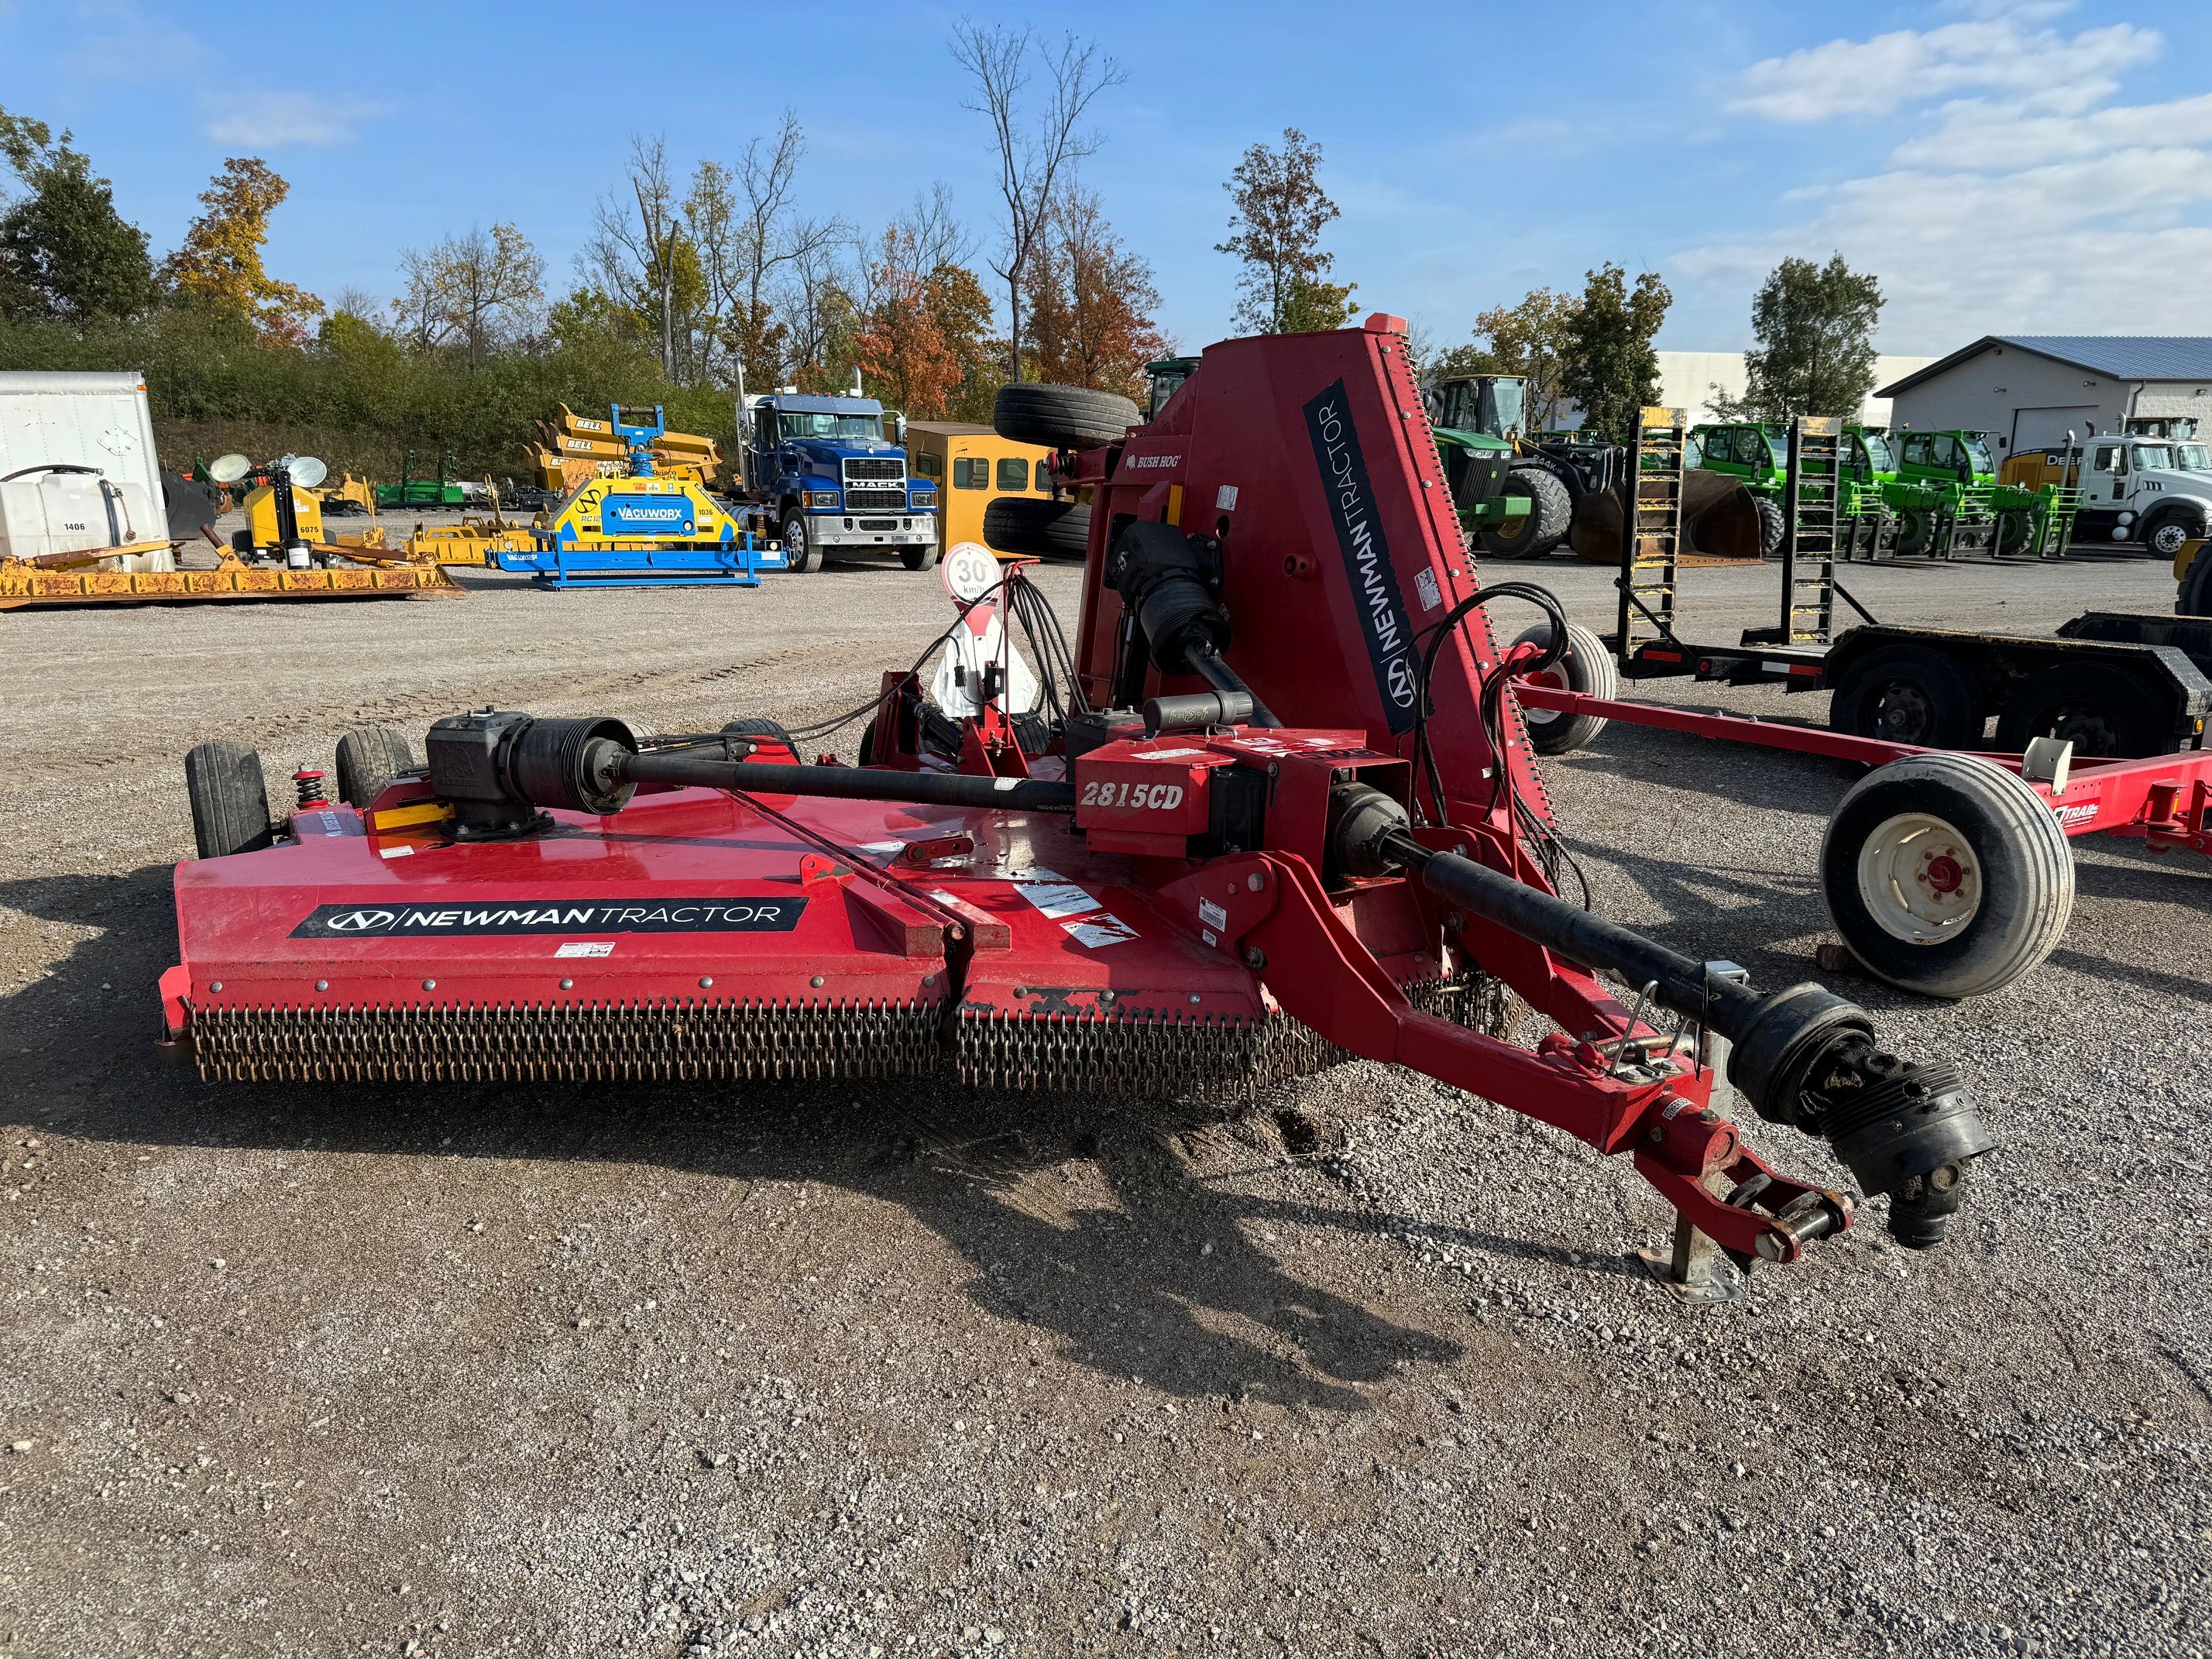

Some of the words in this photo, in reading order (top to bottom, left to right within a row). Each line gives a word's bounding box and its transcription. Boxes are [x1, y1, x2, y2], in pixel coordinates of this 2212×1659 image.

[575, 418, 602, 431] BELL
[566, 439, 593, 450] BELL
[1137, 455, 1160, 469] BUSH
[1318, 398, 1364, 527] TRACTOR
[617, 507, 682, 519] VACUWORX
[64, 523, 85, 531] 1406
[957, 559, 986, 582] 30
[963, 586, 985, 594] km/h
[1349, 520, 1401, 653] NEWMAN
[1080, 781, 1183, 810] 2815CD
[404, 908, 596, 927] NEWMAN
[600, 906, 781, 923] TRACTOR
